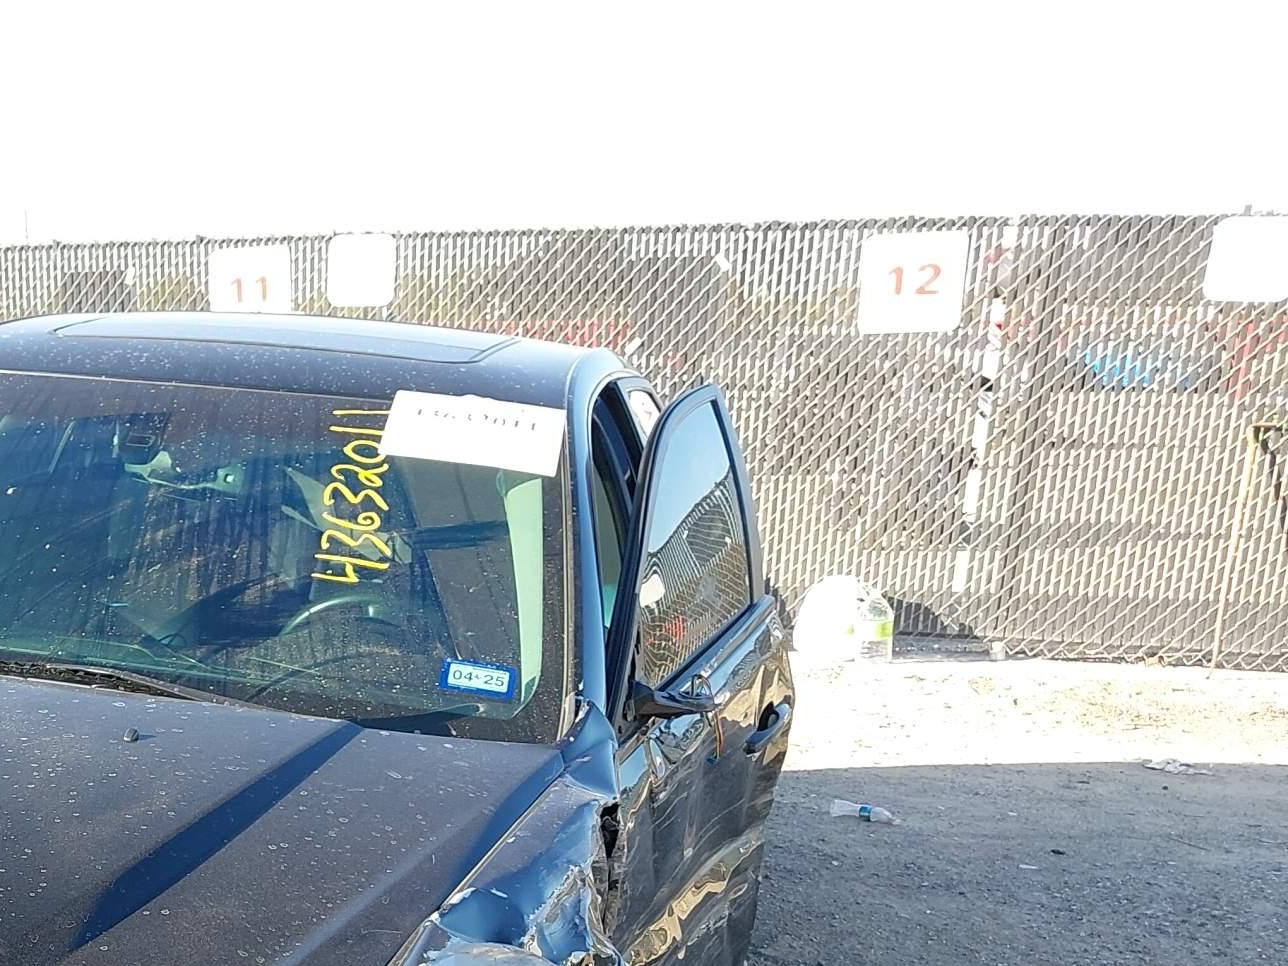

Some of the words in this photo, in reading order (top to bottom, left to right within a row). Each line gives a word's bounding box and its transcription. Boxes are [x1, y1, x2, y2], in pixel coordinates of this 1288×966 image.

[231, 274, 267, 303] 11
[888, 263, 941, 296] 12
[311, 408, 394, 584] 43632011
[452, 669, 473, 682] 04
[483, 674, 505, 687] 25
